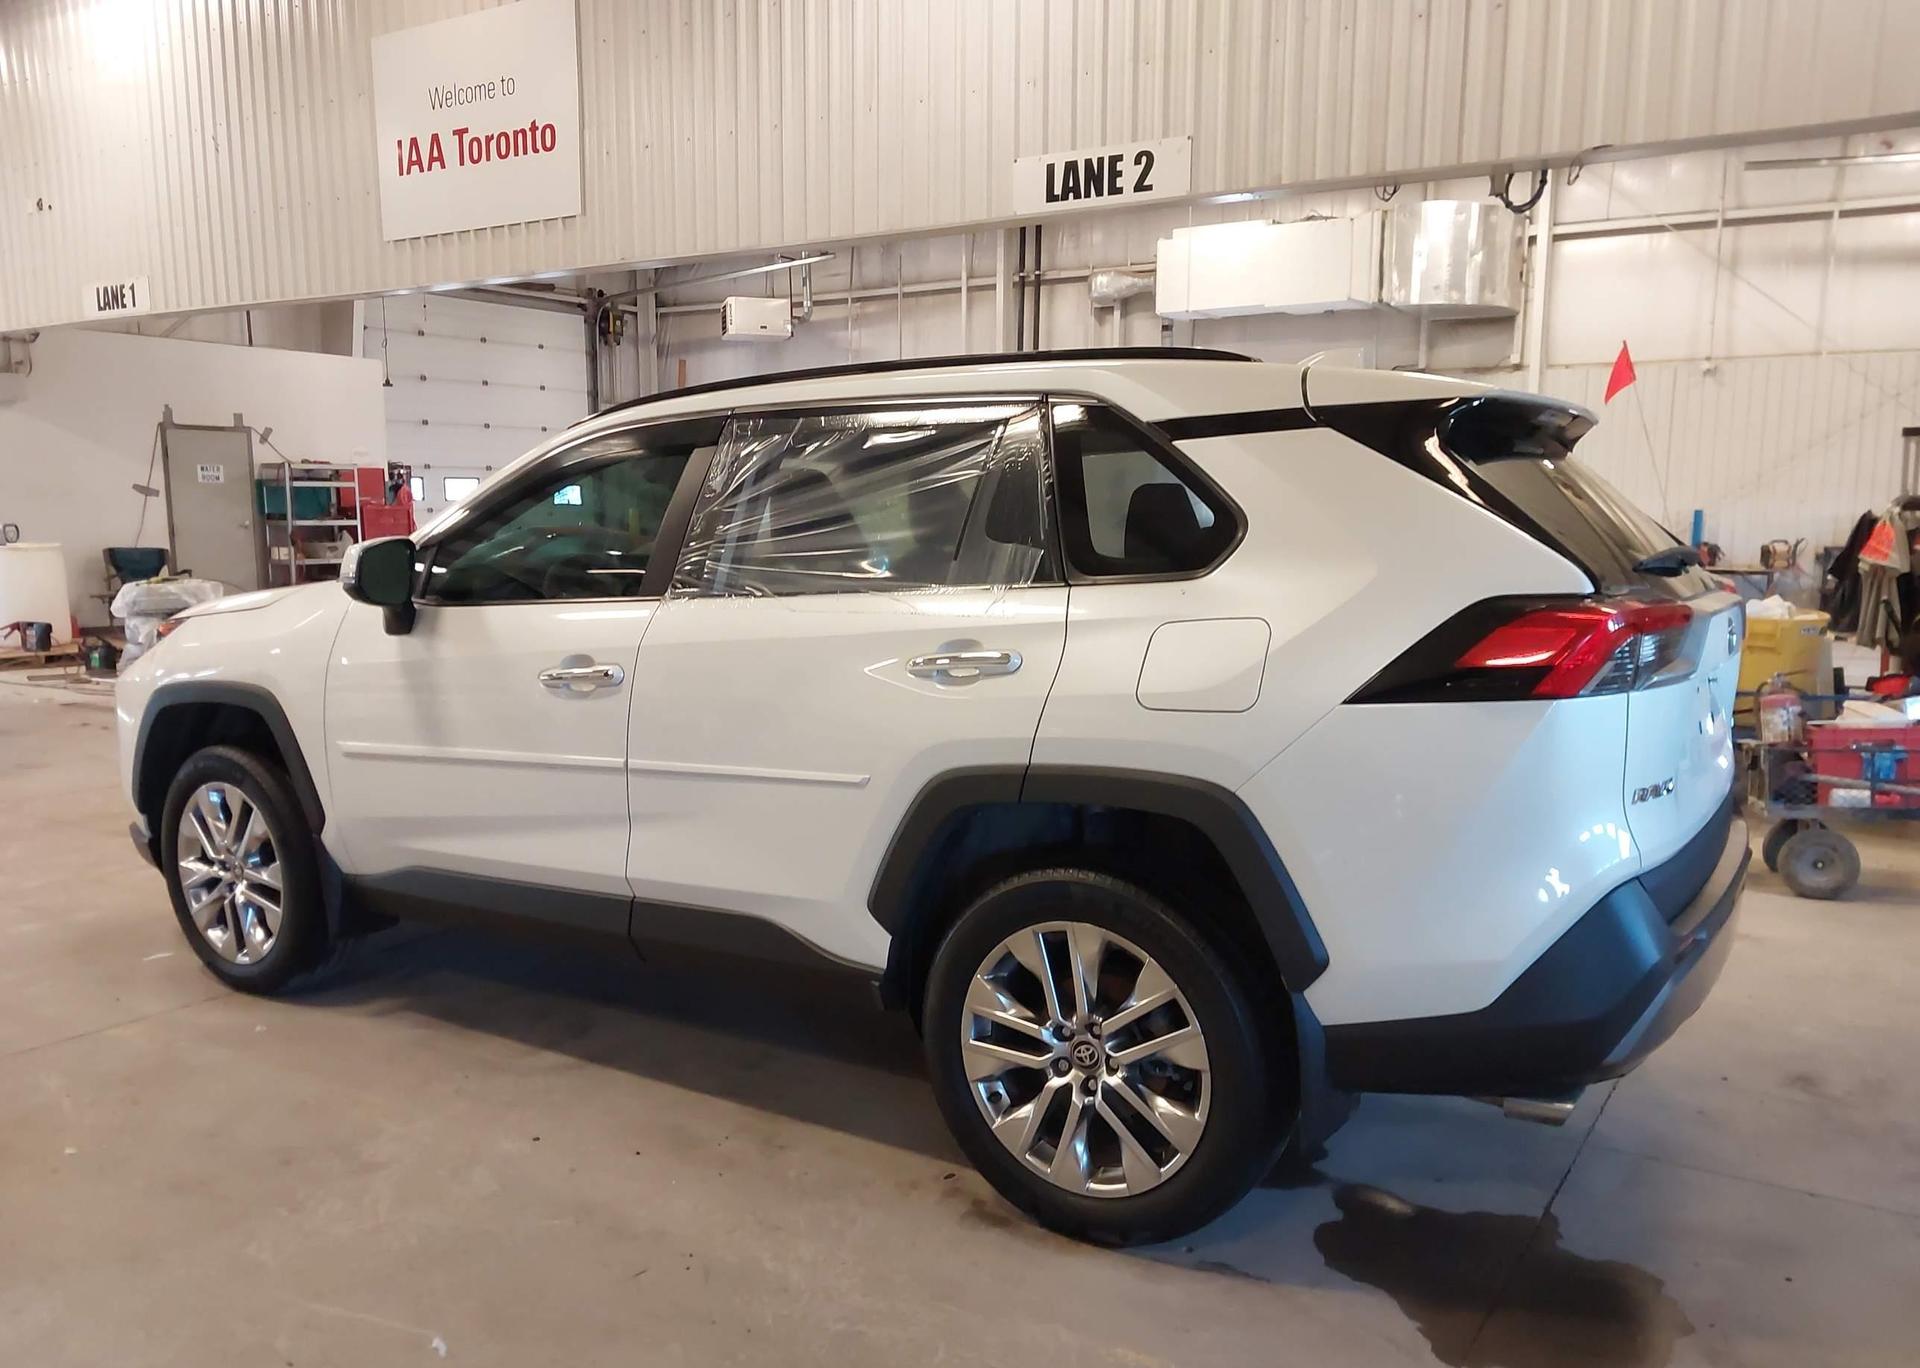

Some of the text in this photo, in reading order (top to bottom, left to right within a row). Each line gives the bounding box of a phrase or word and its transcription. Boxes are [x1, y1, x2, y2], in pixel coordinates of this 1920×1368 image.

[428, 75, 516, 111] Welcome to
[397, 118, 557, 176] IAA Toronto
[1045, 149, 1155, 203] LANE 2
[96, 282, 136, 312] LANE 1
